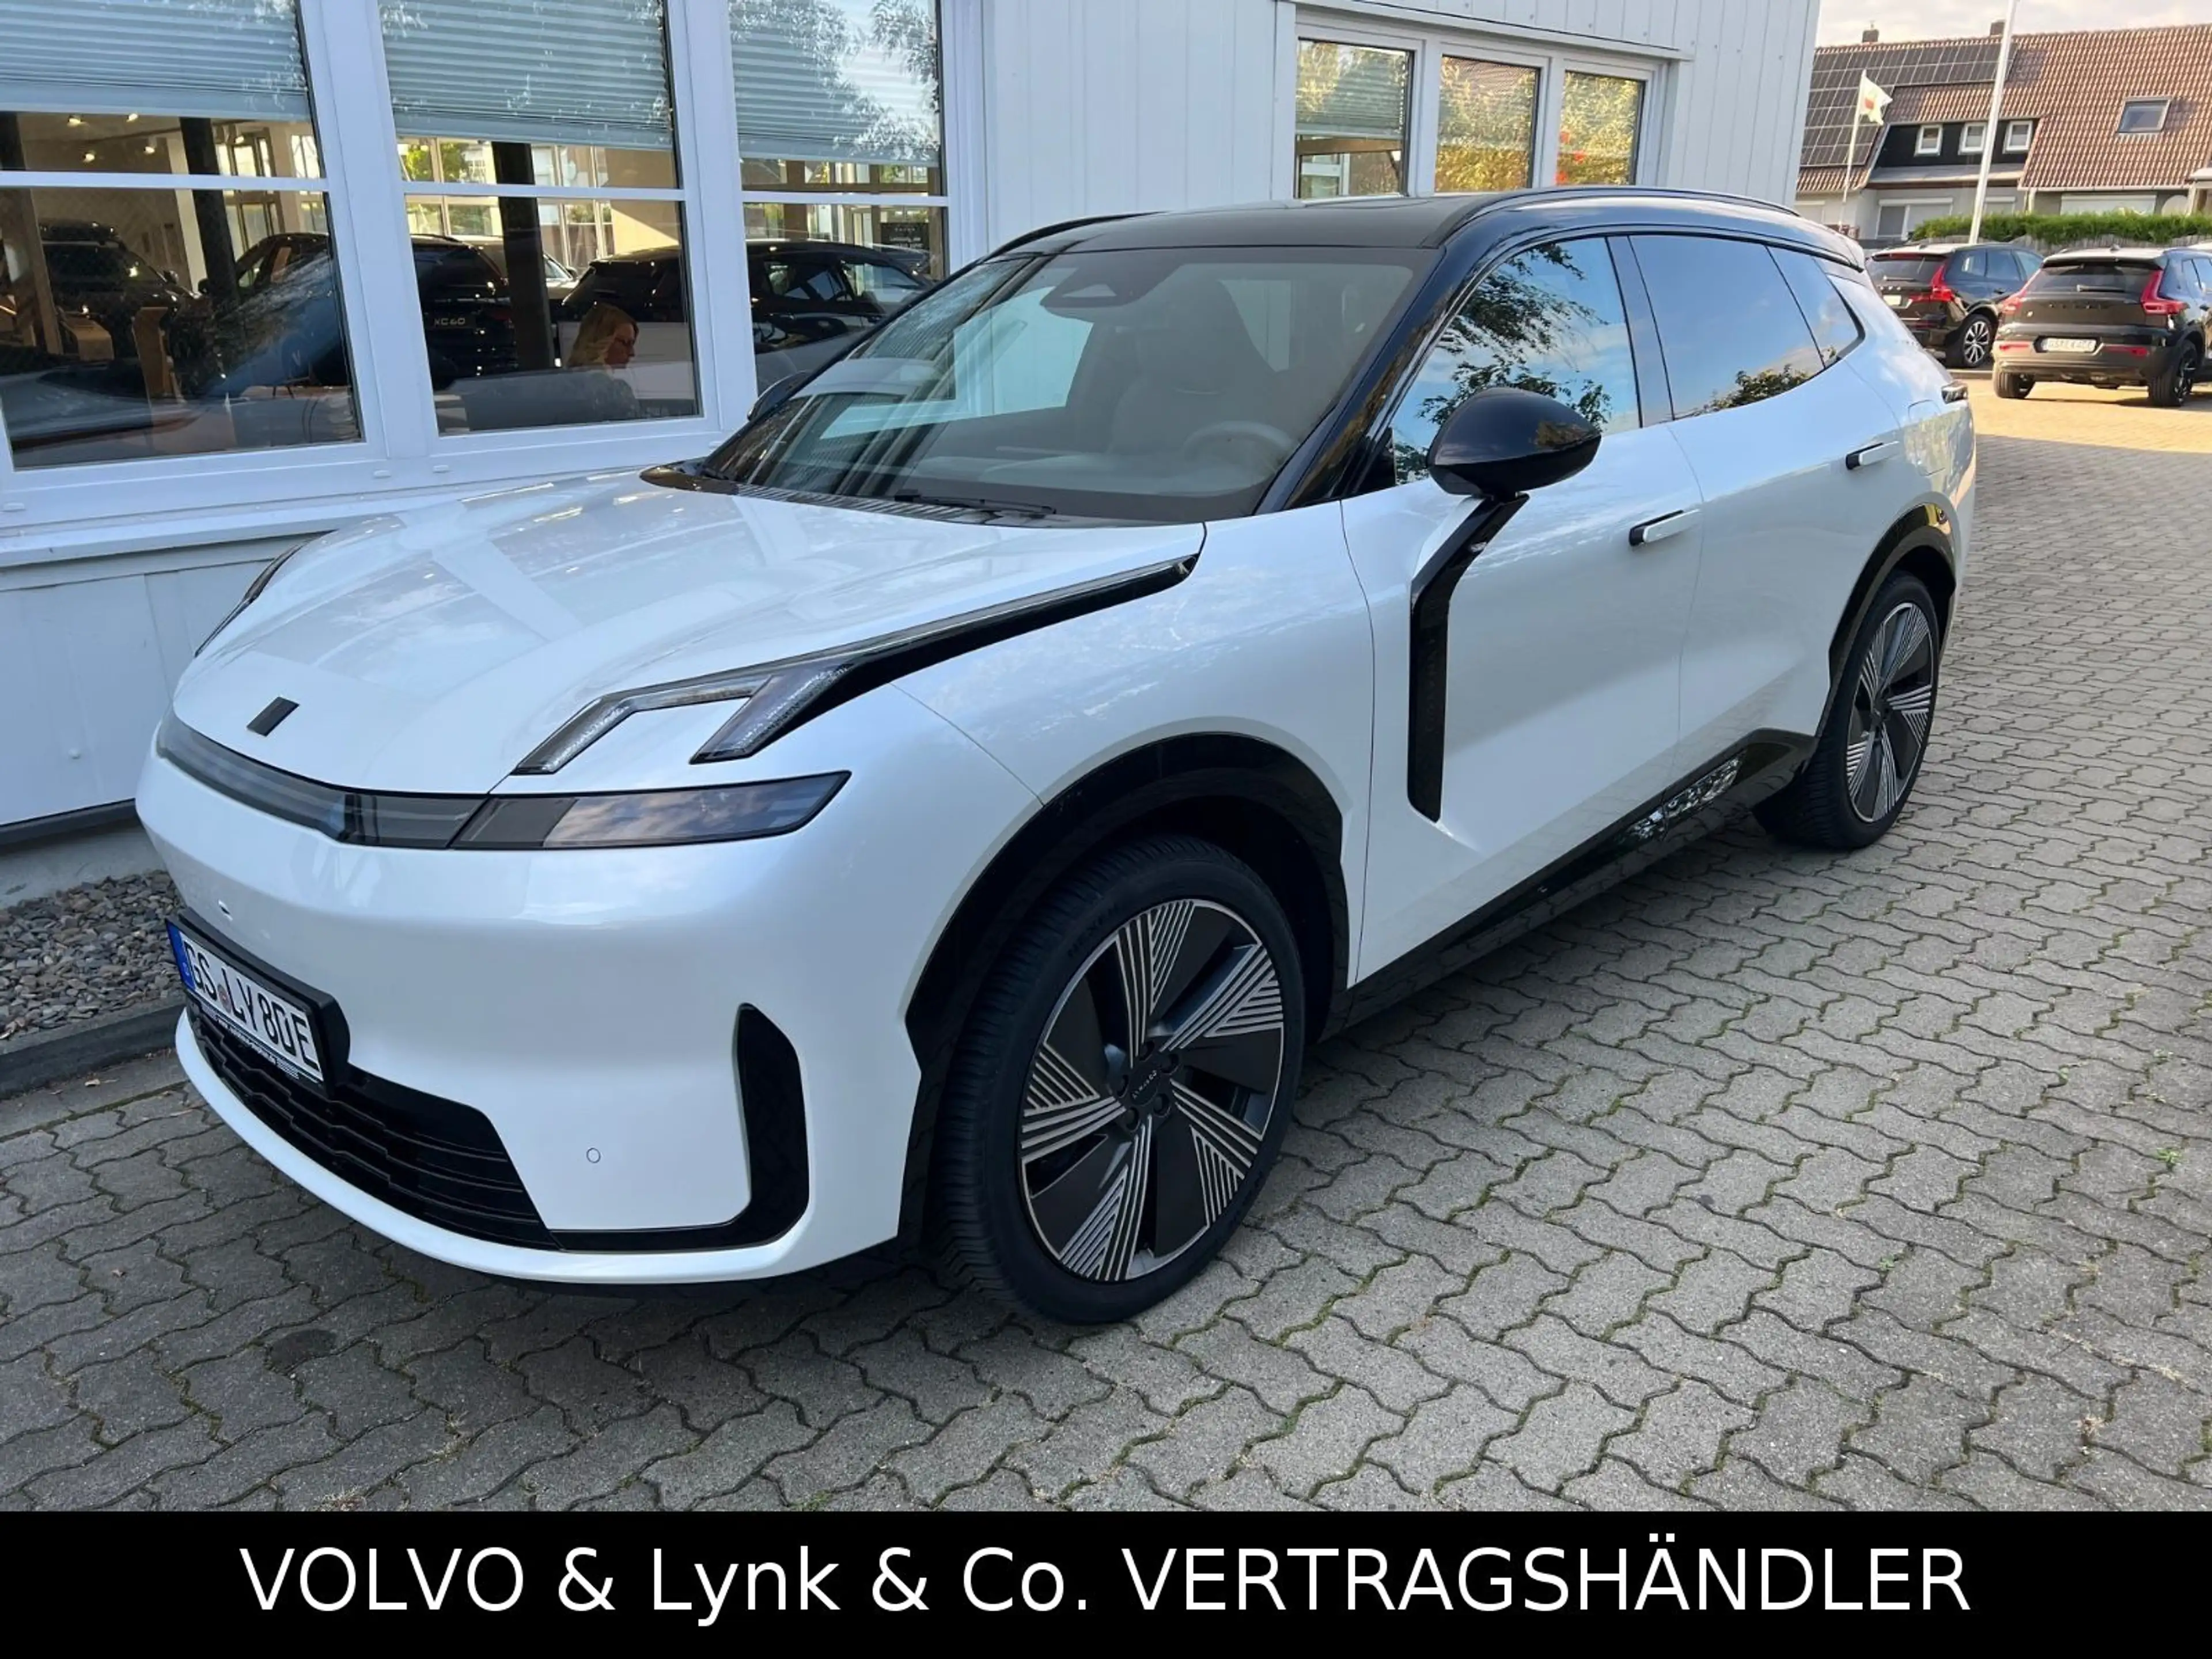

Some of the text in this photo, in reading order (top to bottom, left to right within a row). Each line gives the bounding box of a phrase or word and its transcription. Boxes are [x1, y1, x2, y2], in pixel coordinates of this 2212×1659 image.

[184, 941, 217, 1001] GS
[221, 967, 258, 1032] LY
[257, 992, 319, 1072] 80E
